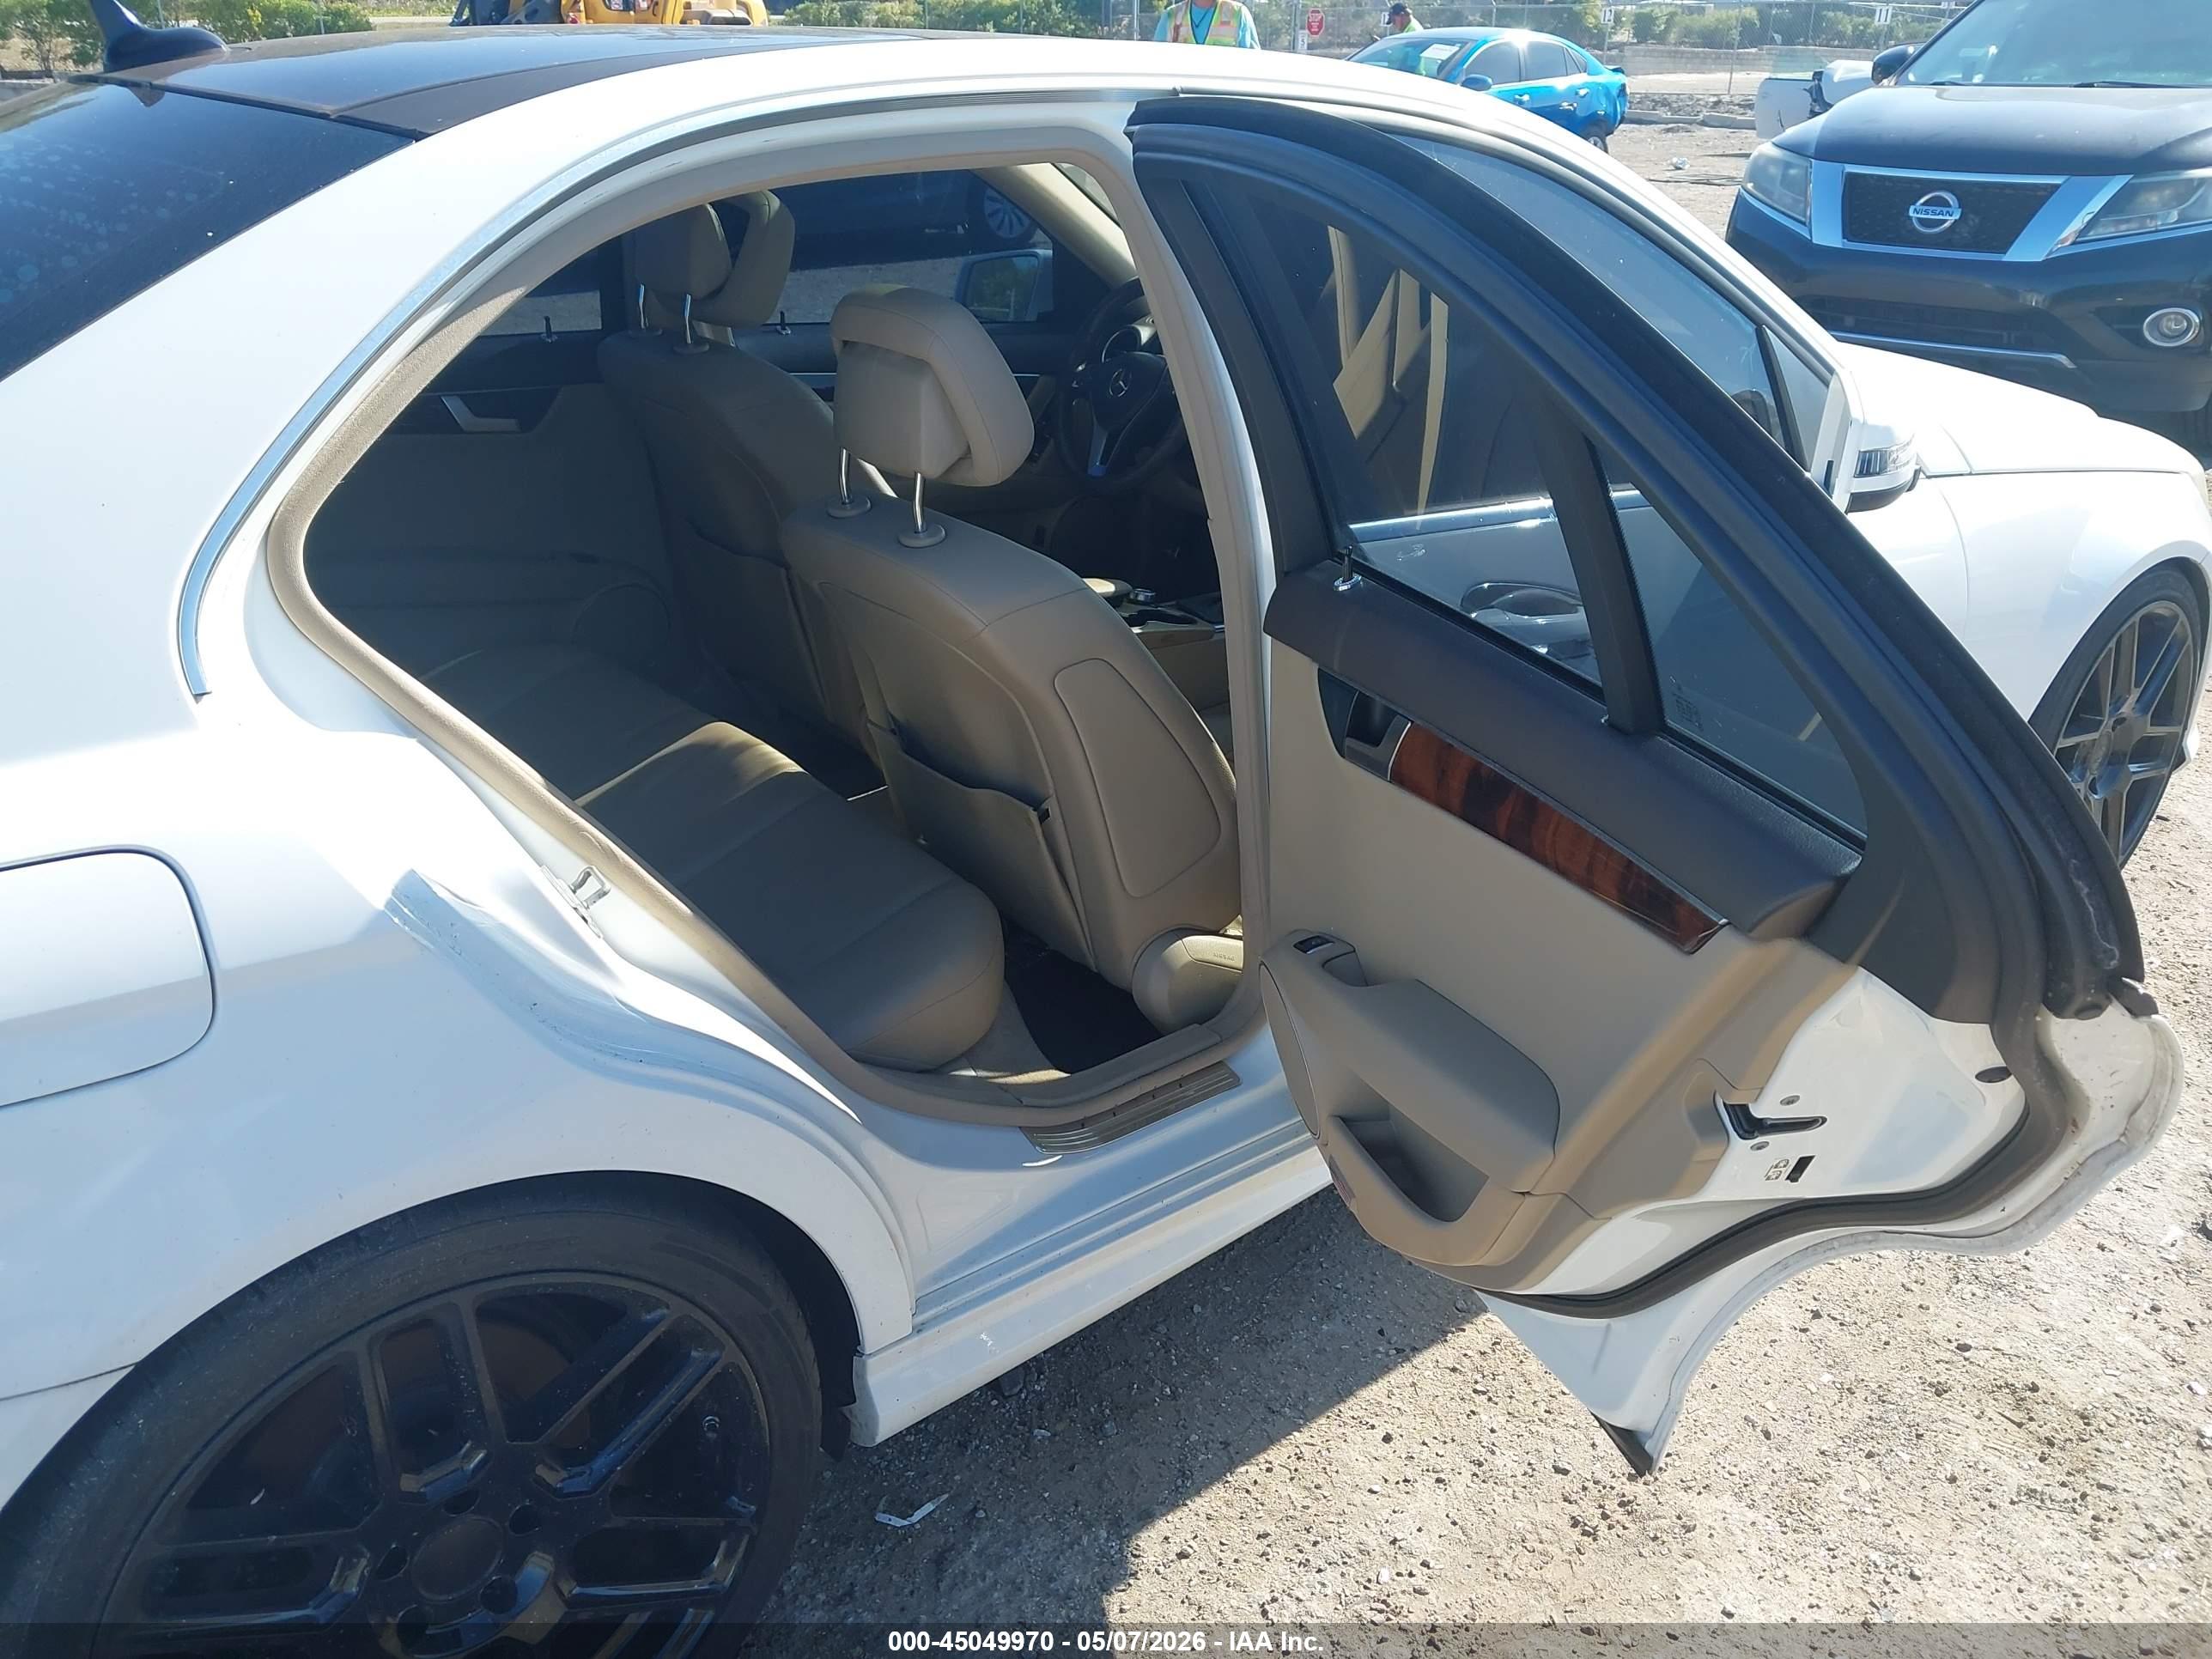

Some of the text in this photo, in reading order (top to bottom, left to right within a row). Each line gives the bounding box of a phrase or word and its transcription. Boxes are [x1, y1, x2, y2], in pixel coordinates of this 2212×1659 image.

[1309, 13, 1322, 21] STOP
[1603, 9, 1613, 22] 12
[1877, 8, 1889, 22] 11
[1912, 208, 1954, 217] NISSAN
